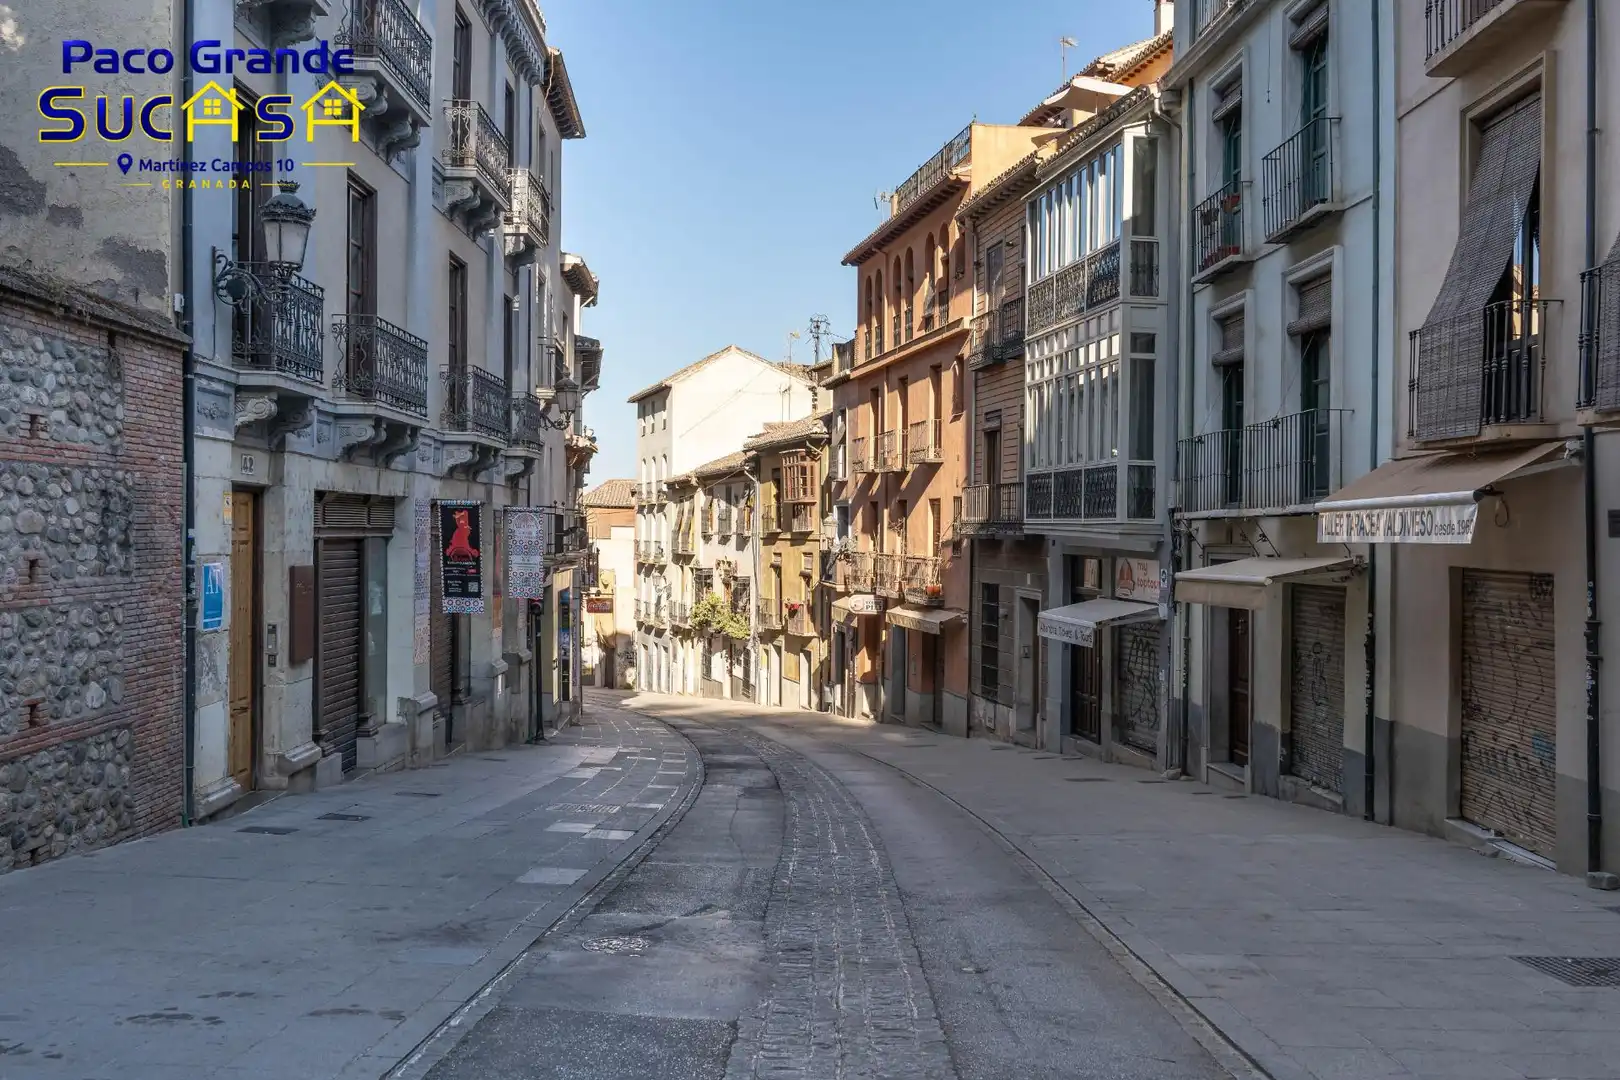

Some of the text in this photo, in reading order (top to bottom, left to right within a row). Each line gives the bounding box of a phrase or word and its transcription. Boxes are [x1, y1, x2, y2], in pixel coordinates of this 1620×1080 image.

[242, 455, 254, 472] 42
[1345, 512, 1380, 536] TARACEA
[1434, 518, 1455, 536] desde
[206, 569, 220, 595] AT
